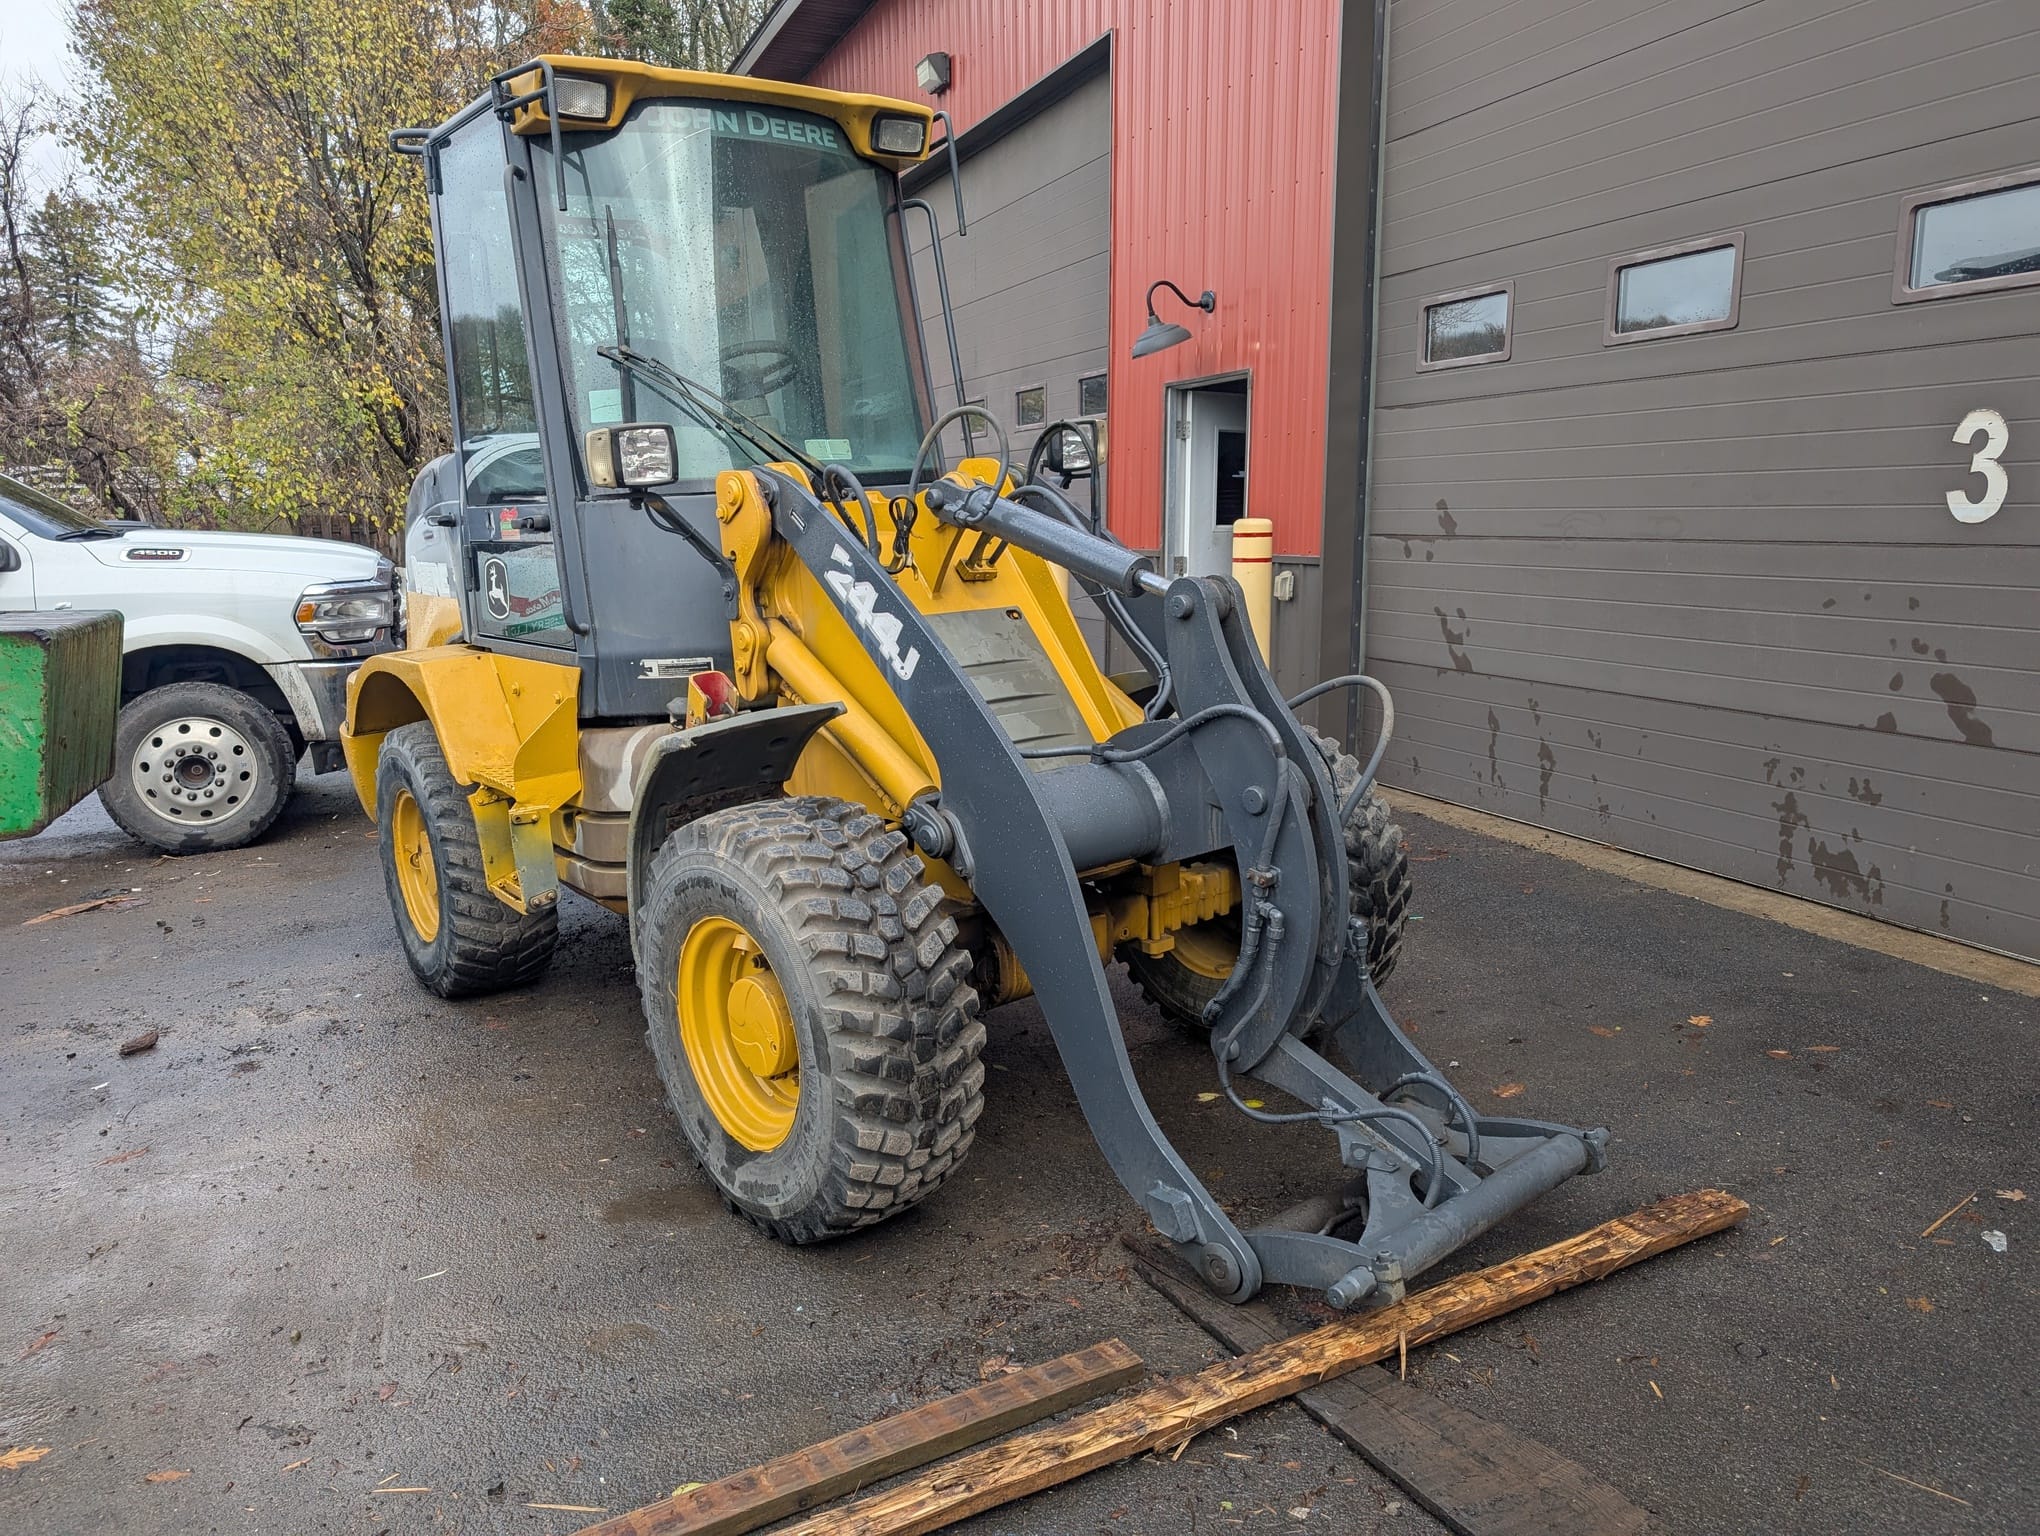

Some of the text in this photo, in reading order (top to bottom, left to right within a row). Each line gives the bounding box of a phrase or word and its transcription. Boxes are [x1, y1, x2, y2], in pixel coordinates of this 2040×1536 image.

[647, 103, 839, 149] JOHN DEERE
[1945, 409, 2009, 524] 3
